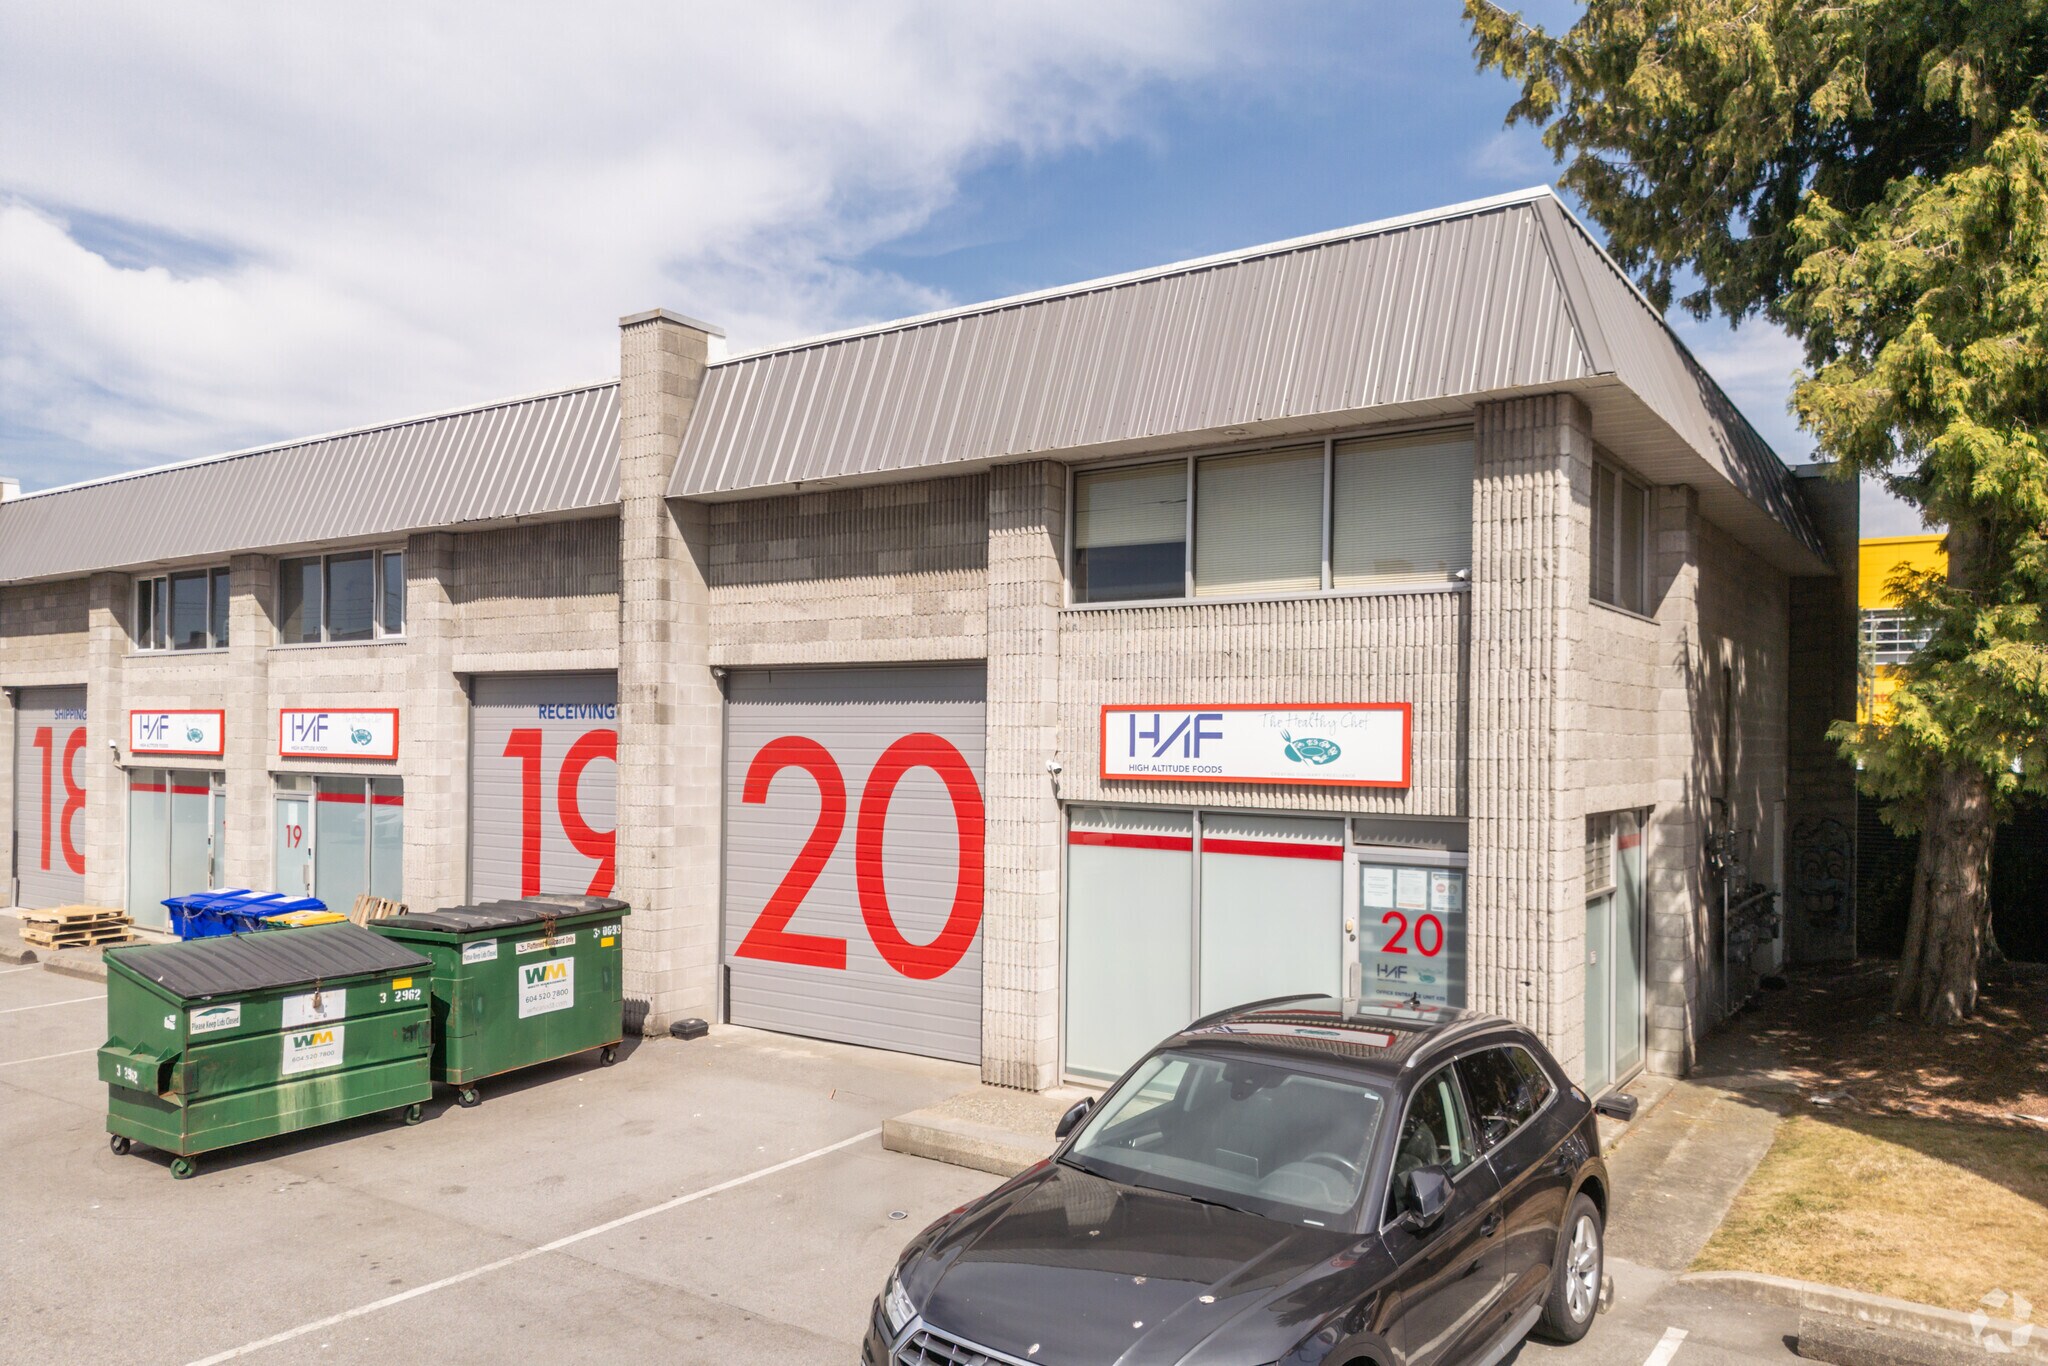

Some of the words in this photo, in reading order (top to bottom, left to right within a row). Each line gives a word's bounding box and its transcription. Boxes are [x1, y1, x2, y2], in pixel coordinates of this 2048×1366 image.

[54, 708, 87, 720] SHIPPING
[538, 703, 615, 720] RECEIVING
[291, 713, 329, 742] HAF
[1285, 711, 1338, 736] Healthy
[1128, 713, 1224, 759] HAF
[1128, 763, 1150, 772] HIGH
[1151, 763, 1190, 773] ALTITUDE
[1192, 764, 1223, 774] FOODS
[285, 824, 302, 849] 19
[734, 732, 985, 980] 20
[1381, 911, 1443, 957] 20
[525, 962, 567, 985] WM
[1376, 963, 1408, 978] HAF
[379, 992, 387, 1004] 3
[394, 989, 422, 1003] 2962
[525, 995, 538, 1004] 604
[539, 991, 551, 1001] 520
[552, 988, 569, 998] 7800
[192, 1022, 206, 1031] Please
[206, 1020, 217, 1029] Keep
[217, 1018, 226, 1027] Lids
[226, 1015, 239, 1025] Closed
[293, 1031, 334, 1049] WM
[291, 1055, 304, 1063] 604
[319, 1050, 335, 1058] 7800
